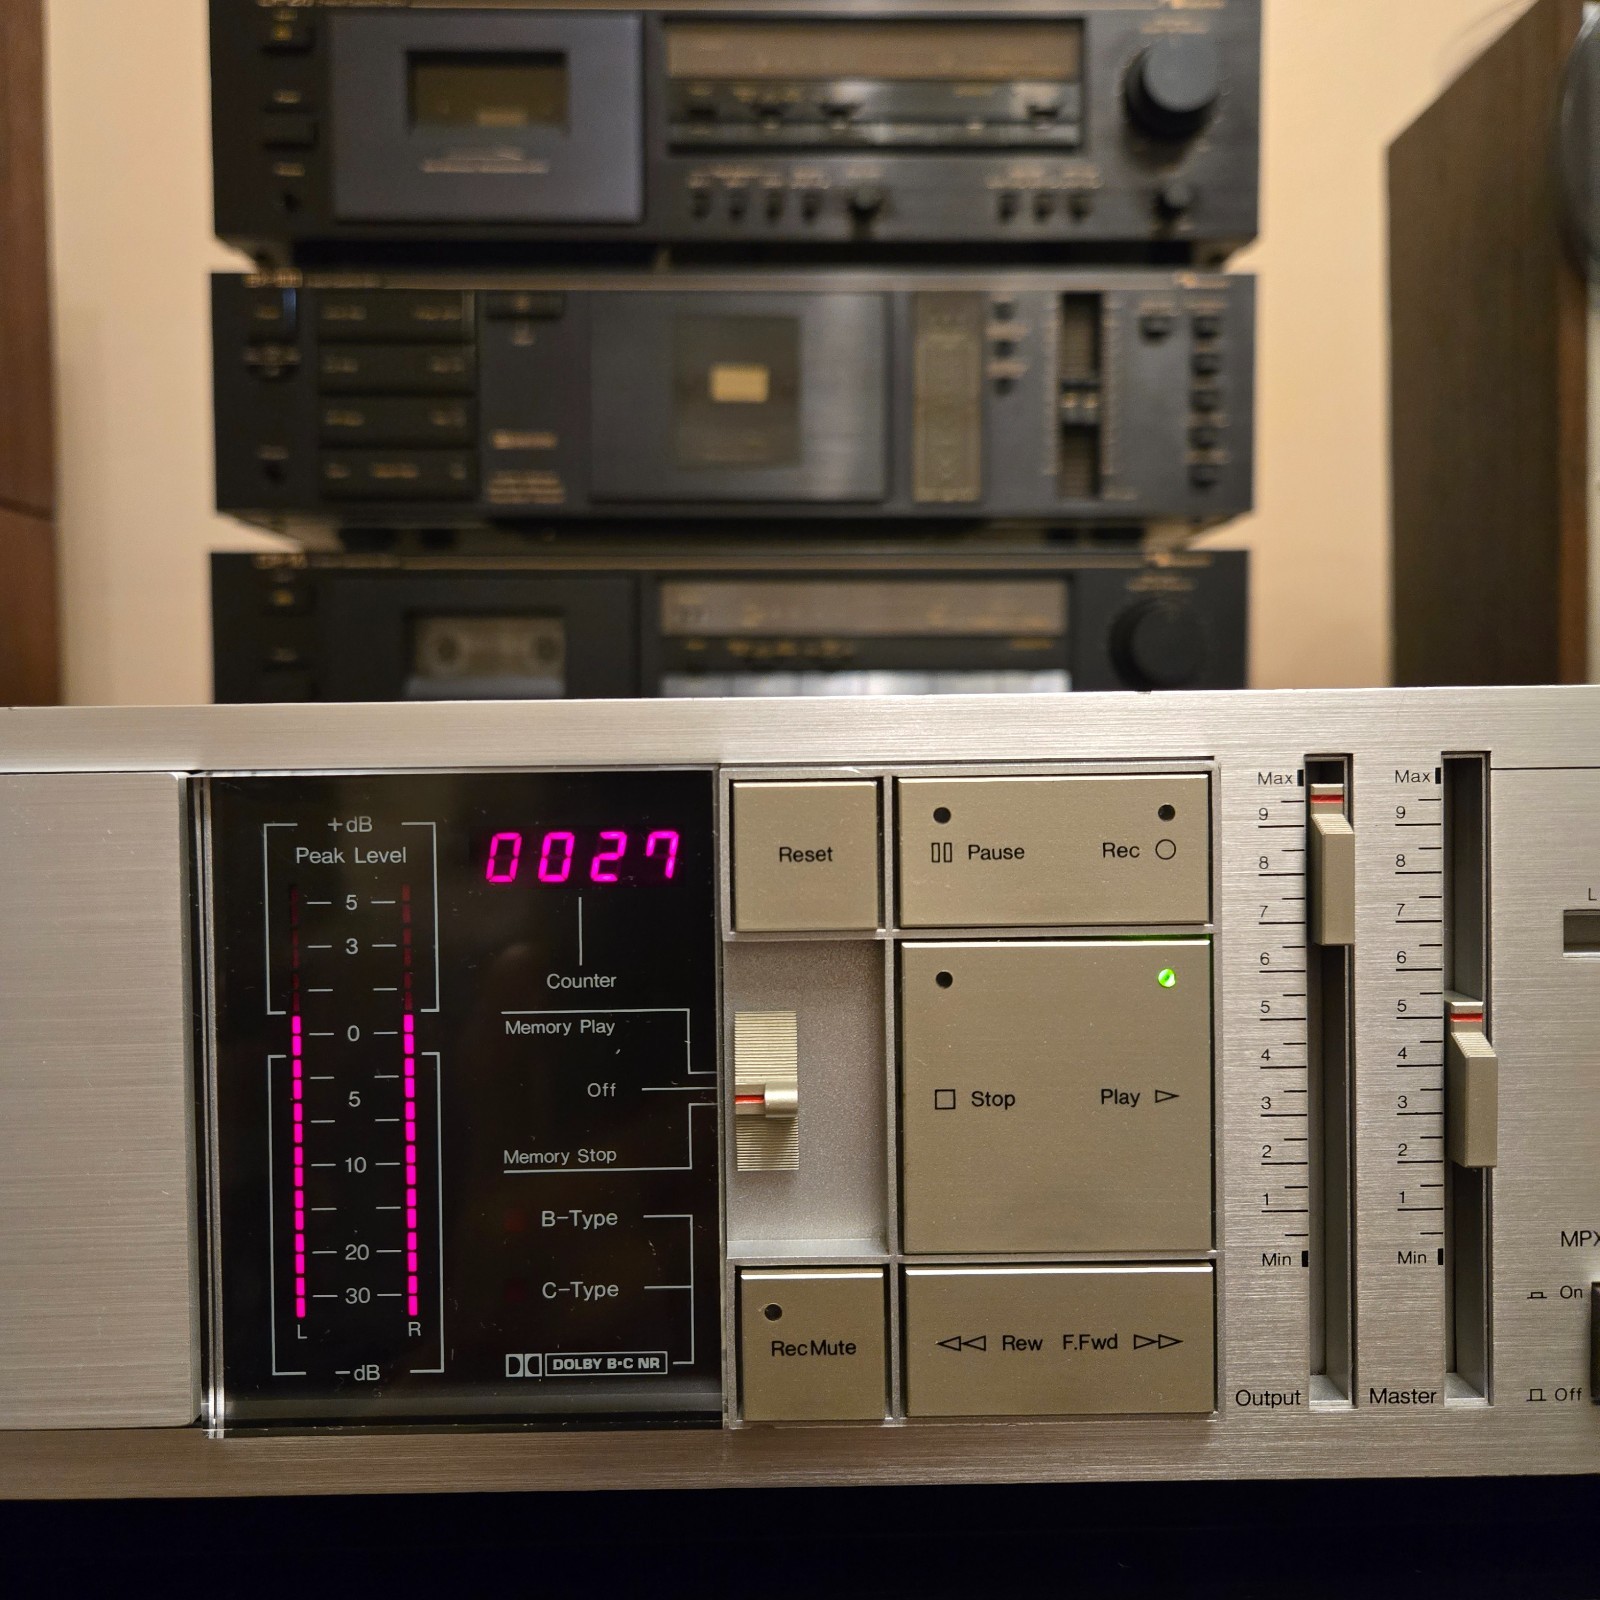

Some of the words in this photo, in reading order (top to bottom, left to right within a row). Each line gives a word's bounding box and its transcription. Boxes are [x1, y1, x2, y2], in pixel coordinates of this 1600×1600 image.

[1257, 771, 1293, 785] Max
[1395, 769, 1431, 783] Max
[1258, 807, 1269, 821] 9
[1395, 805, 1406, 819] 9
[296, 846, 346, 864] Peak
[354, 846, 407, 864] Level
[485, 829, 680, 884] 0027
[779, 846, 833, 863] Reset
[968, 844, 1025, 861] Pause
[1102, 842, 1140, 859] Rec
[1258, 855, 1269, 870] 8
[1395, 853, 1406, 868] 8
[345, 894, 359, 911] 5
[1396, 903, 1406, 917] 7
[1259, 905, 1269, 918] 7
[345, 937, 359, 955] 3
[1259, 951, 1270, 966] 6
[1396, 950, 1407, 964] 6
[546, 973, 617, 990] Counter
[1260, 1000, 1271, 1014] 5
[1397, 999, 1407, 1013] 5
[347, 1024, 360, 1042] 0
[505, 1020, 572, 1036] Memory
[580, 1019, 616, 1037] Play
[1260, 1048, 1271, 1062] 4
[1397, 1046, 1408, 1060] 4
[587, 1082, 617, 1098] Off
[1100, 1088, 1141, 1108] Play
[348, 1090, 361, 1108] 5
[971, 1090, 1016, 1111] Stop
[1260, 1096, 1272, 1110] 3
[1397, 1095, 1408, 1109] 3
[503, 1149, 570, 1166] Memory
[577, 1148, 617, 1164] Stop
[1261, 1144, 1272, 1159] 2
[1397, 1142, 1408, 1157] 2
[345, 1156, 367, 1174] 10
[1263, 1192, 1269, 1206] 1
[1399, 1190, 1405, 1204] 1
[541, 1209, 618, 1230] B-Type
[345, 1243, 370, 1261] 20
[1261, 1252, 1292, 1267] Min
[1397, 1250, 1427, 1265] Min
[345, 1286, 371, 1305] 30
[542, 1281, 619, 1302] C-Type
[1559, 1285, 1583, 1300] On
[297, 1324, 308, 1340] L
[408, 1321, 422, 1337] R
[1002, 1334, 1044, 1352] Rew
[1062, 1333, 1118, 1351] F.Fwd
[552, 1357, 603, 1371] DOLBY
[637, 1357, 660, 1369] NR
[1235, 1389, 1302, 1409] Output
[1369, 1387, 1437, 1405] Master
[1554, 1387, 1583, 1402] Off
